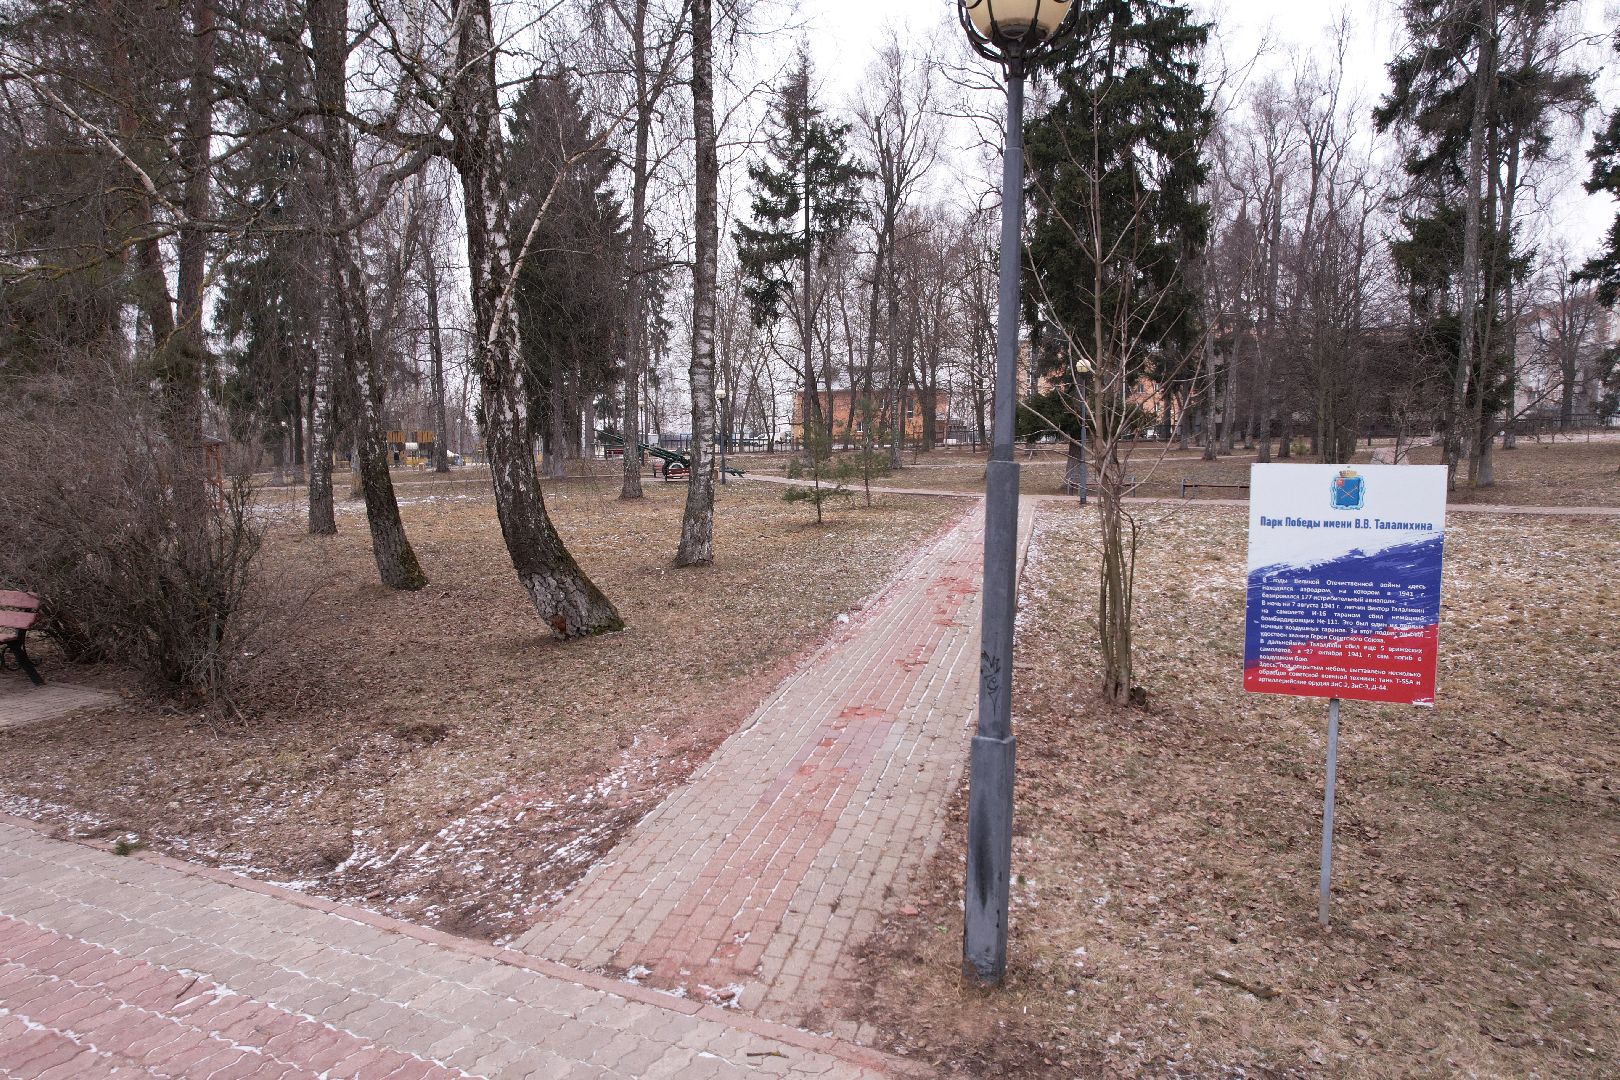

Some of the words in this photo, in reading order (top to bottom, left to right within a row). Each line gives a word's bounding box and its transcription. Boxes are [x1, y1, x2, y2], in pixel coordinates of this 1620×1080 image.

[1260, 516, 1282, 528] Парк
[1285, 517, 1320, 528] Победы
[1324, 519, 1352, 528] имени
[1355, 519, 1372, 529] В.В.
[1375, 519, 1432, 530] Талалихина
[1261, 616, 1314, 624] бомбардировщик
